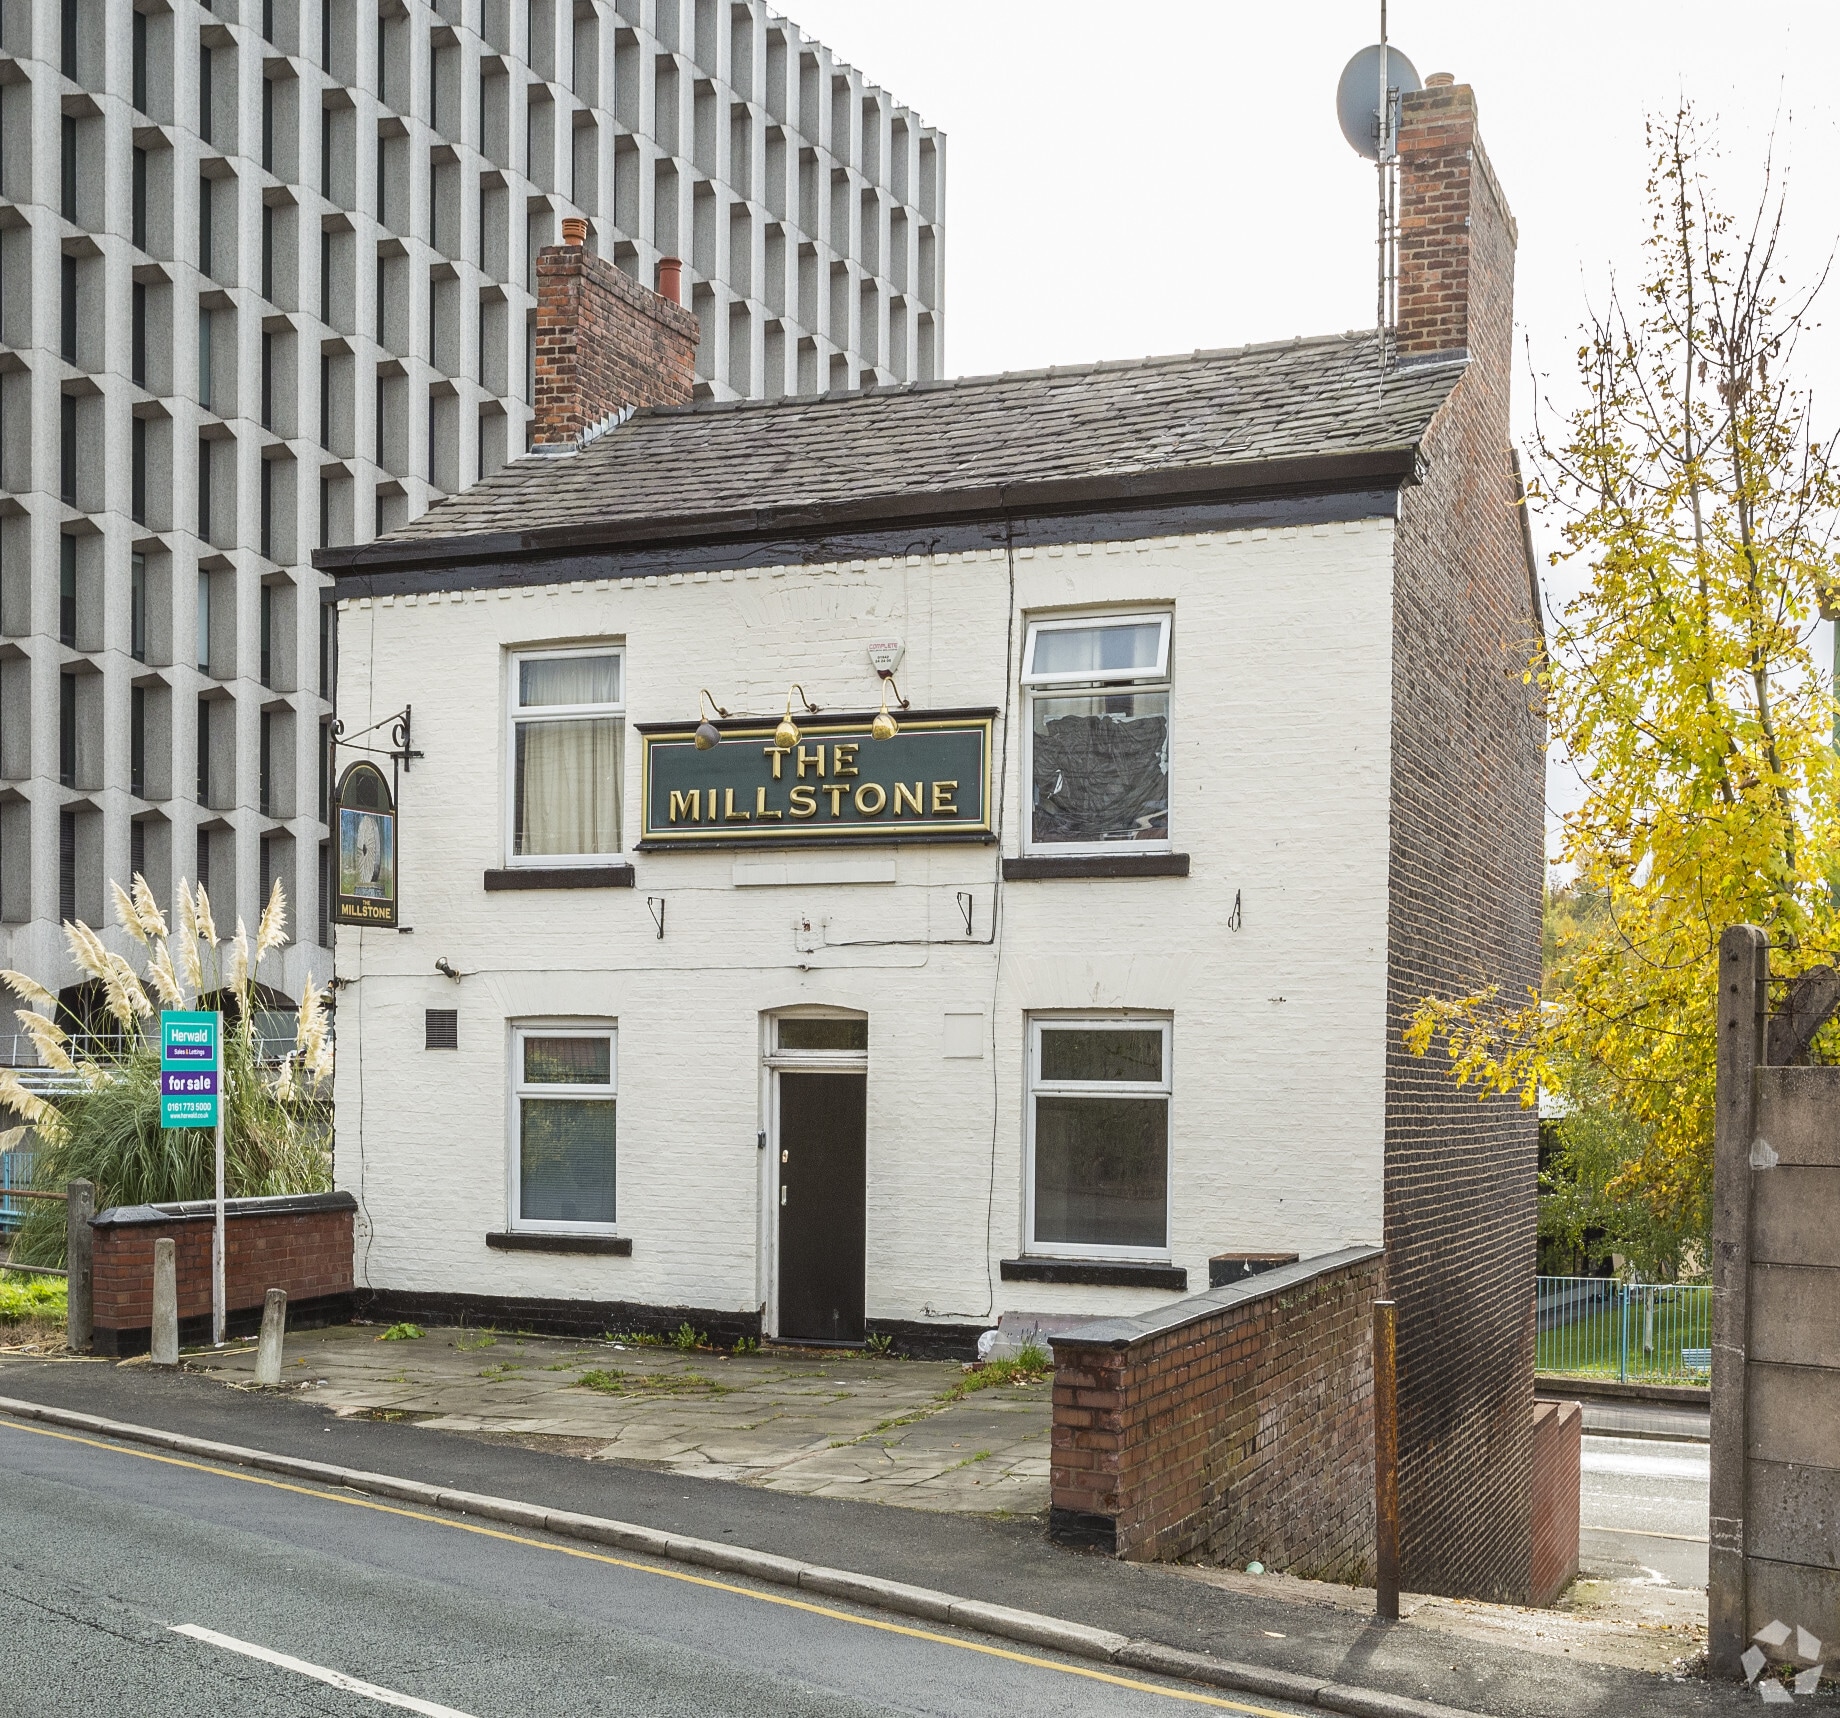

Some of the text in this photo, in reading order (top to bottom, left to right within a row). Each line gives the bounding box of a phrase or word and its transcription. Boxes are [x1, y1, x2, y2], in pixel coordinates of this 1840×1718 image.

[763, 743, 860, 780] THE
[669, 780, 959, 823] MILLSTONE
[341, 904, 392, 919] MILLSTONE
[171, 1029, 208, 1043] Herwald
[189, 1049, 205, 1057] Lettings
[168, 1075, 211, 1091] for sale
[167, 1102, 212, 1112] 0161 773 5000
